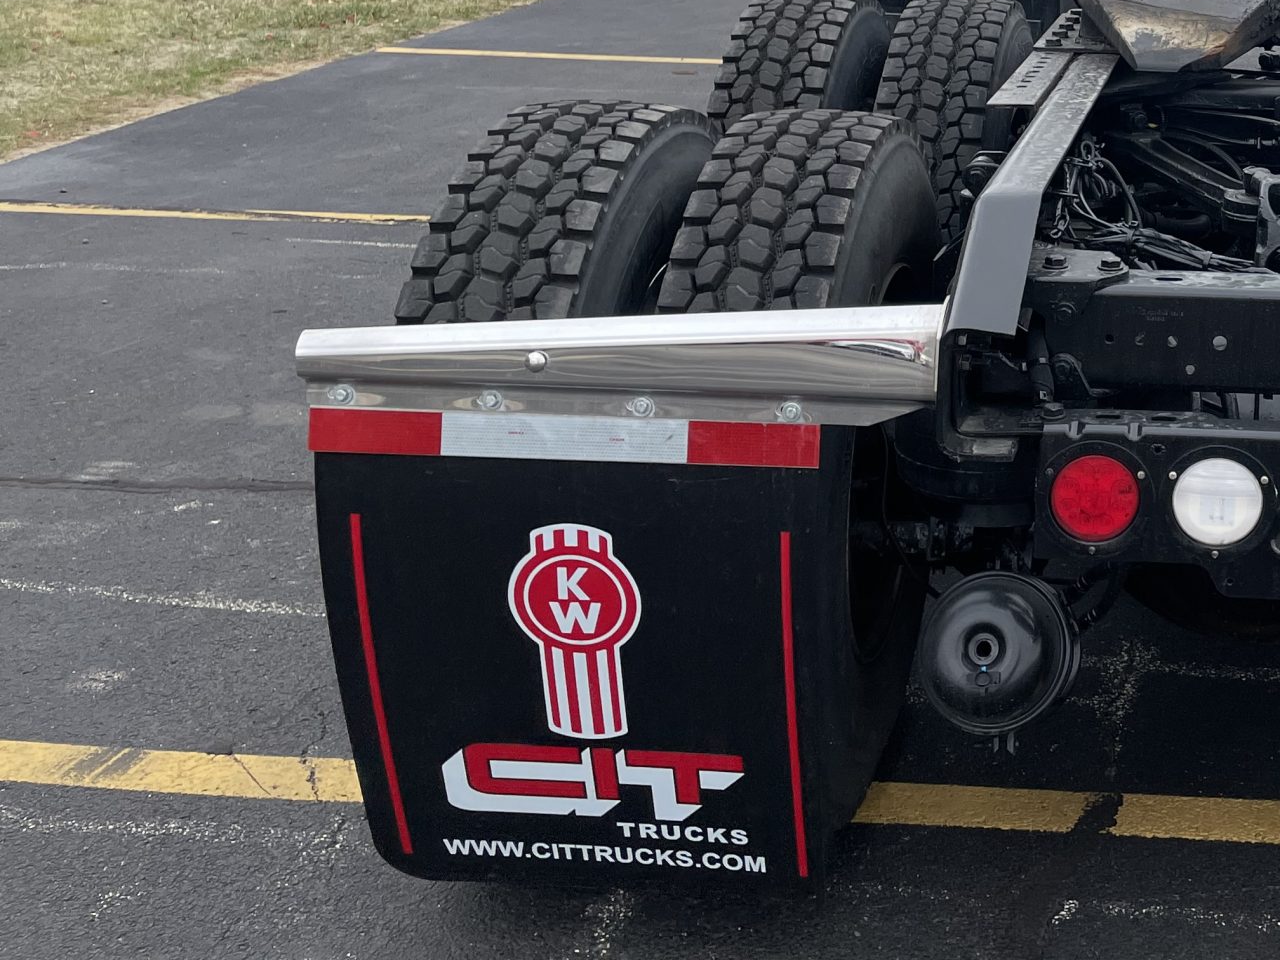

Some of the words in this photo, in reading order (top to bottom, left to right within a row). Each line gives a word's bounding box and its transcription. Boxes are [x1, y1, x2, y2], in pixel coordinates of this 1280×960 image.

[441, 742, 745, 821] CIT
[617, 821, 749, 846] TRUCKS
[442, 837, 767, 874] WWW.CITTRUCKS.COM
